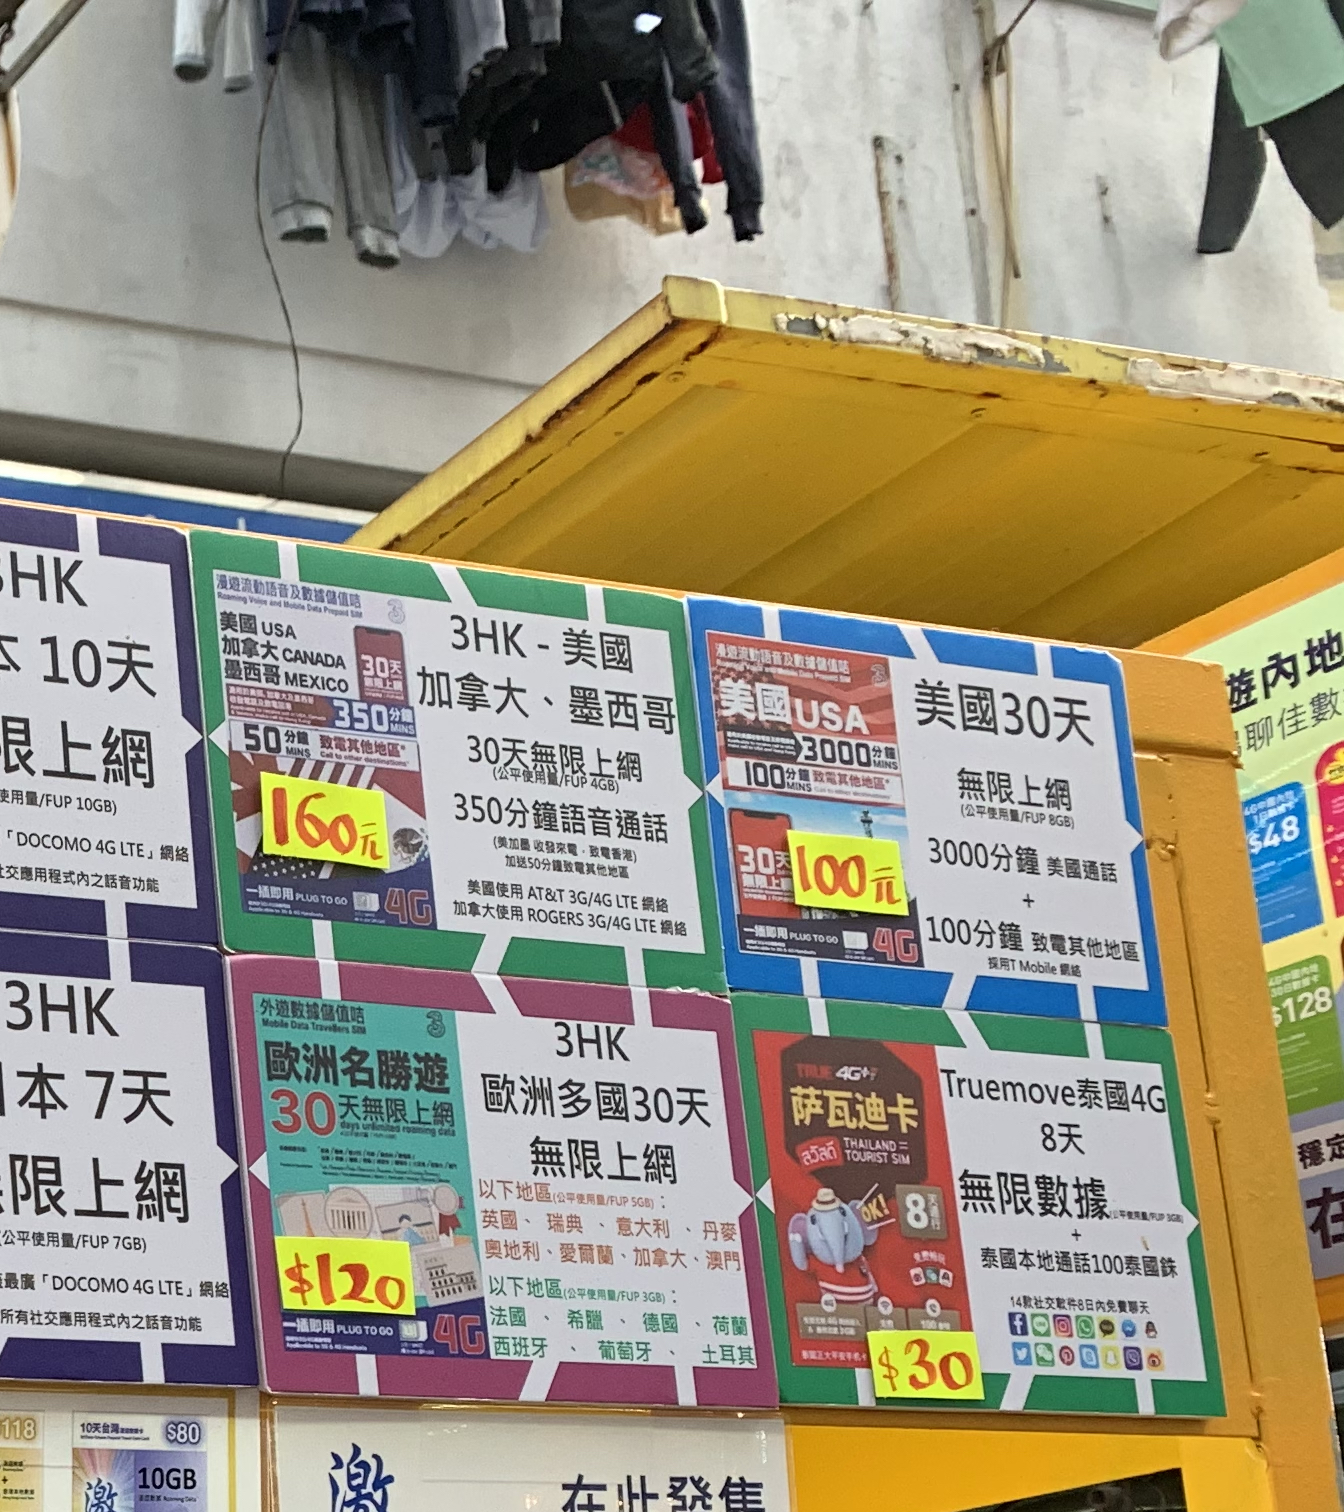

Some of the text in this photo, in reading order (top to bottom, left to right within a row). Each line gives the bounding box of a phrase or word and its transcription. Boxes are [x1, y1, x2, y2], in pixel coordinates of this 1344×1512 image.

[220, 611, 296, 641] 美國 USA
[40, 635, 156, 698] 10天
[223, 636, 346, 670] 加拿大 CANADA
[224, 659, 349, 694] 墨西哥 MEXICO
[718, 678, 870, 735] 美國 USA
[913, 678, 1095, 747] 美國30天
[468, 736, 642, 783] 30天無限上網
[956, 767, 1072, 812] 無限上網
[272, 787, 383, 860] 160元
[454, 793, 668, 844] 350分鐘語音通話
[1248, 815, 1300, 854] $48
[795, 845, 902, 906] 100元
[928, 837, 1118, 884] 3000分鐘 美國通話
[5, 980, 119, 1038] 3HK
[555, 1021, 630, 1062] 3HK
[264, 1039, 450, 1094] 歐洲名勝遊
[85, 1068, 175, 1127] 7天
[481, 1073, 712, 1129] 歐洲多國30天
[790, 1085, 919, 1133] 萨瓦迪卡
[940, 1068, 1167, 1115] Truemove泰國4G
[531, 1136, 678, 1185] 無限上網
[843, 1137, 896, 1150] THAILAND
[845, 1150, 910, 1165] TOURIST SIM
[1041, 1123, 1086, 1155] 8天
[958, 1168, 1111, 1222] 無限數據
[285, 1252, 405, 1311] $120
[980, 1247, 1178, 1279] 泰國本地通話100泰國銖
[877, 1338, 973, 1392] $30
[164, 1420, 202, 1445] $80
[138, 1466, 197, 1493] 10GB
